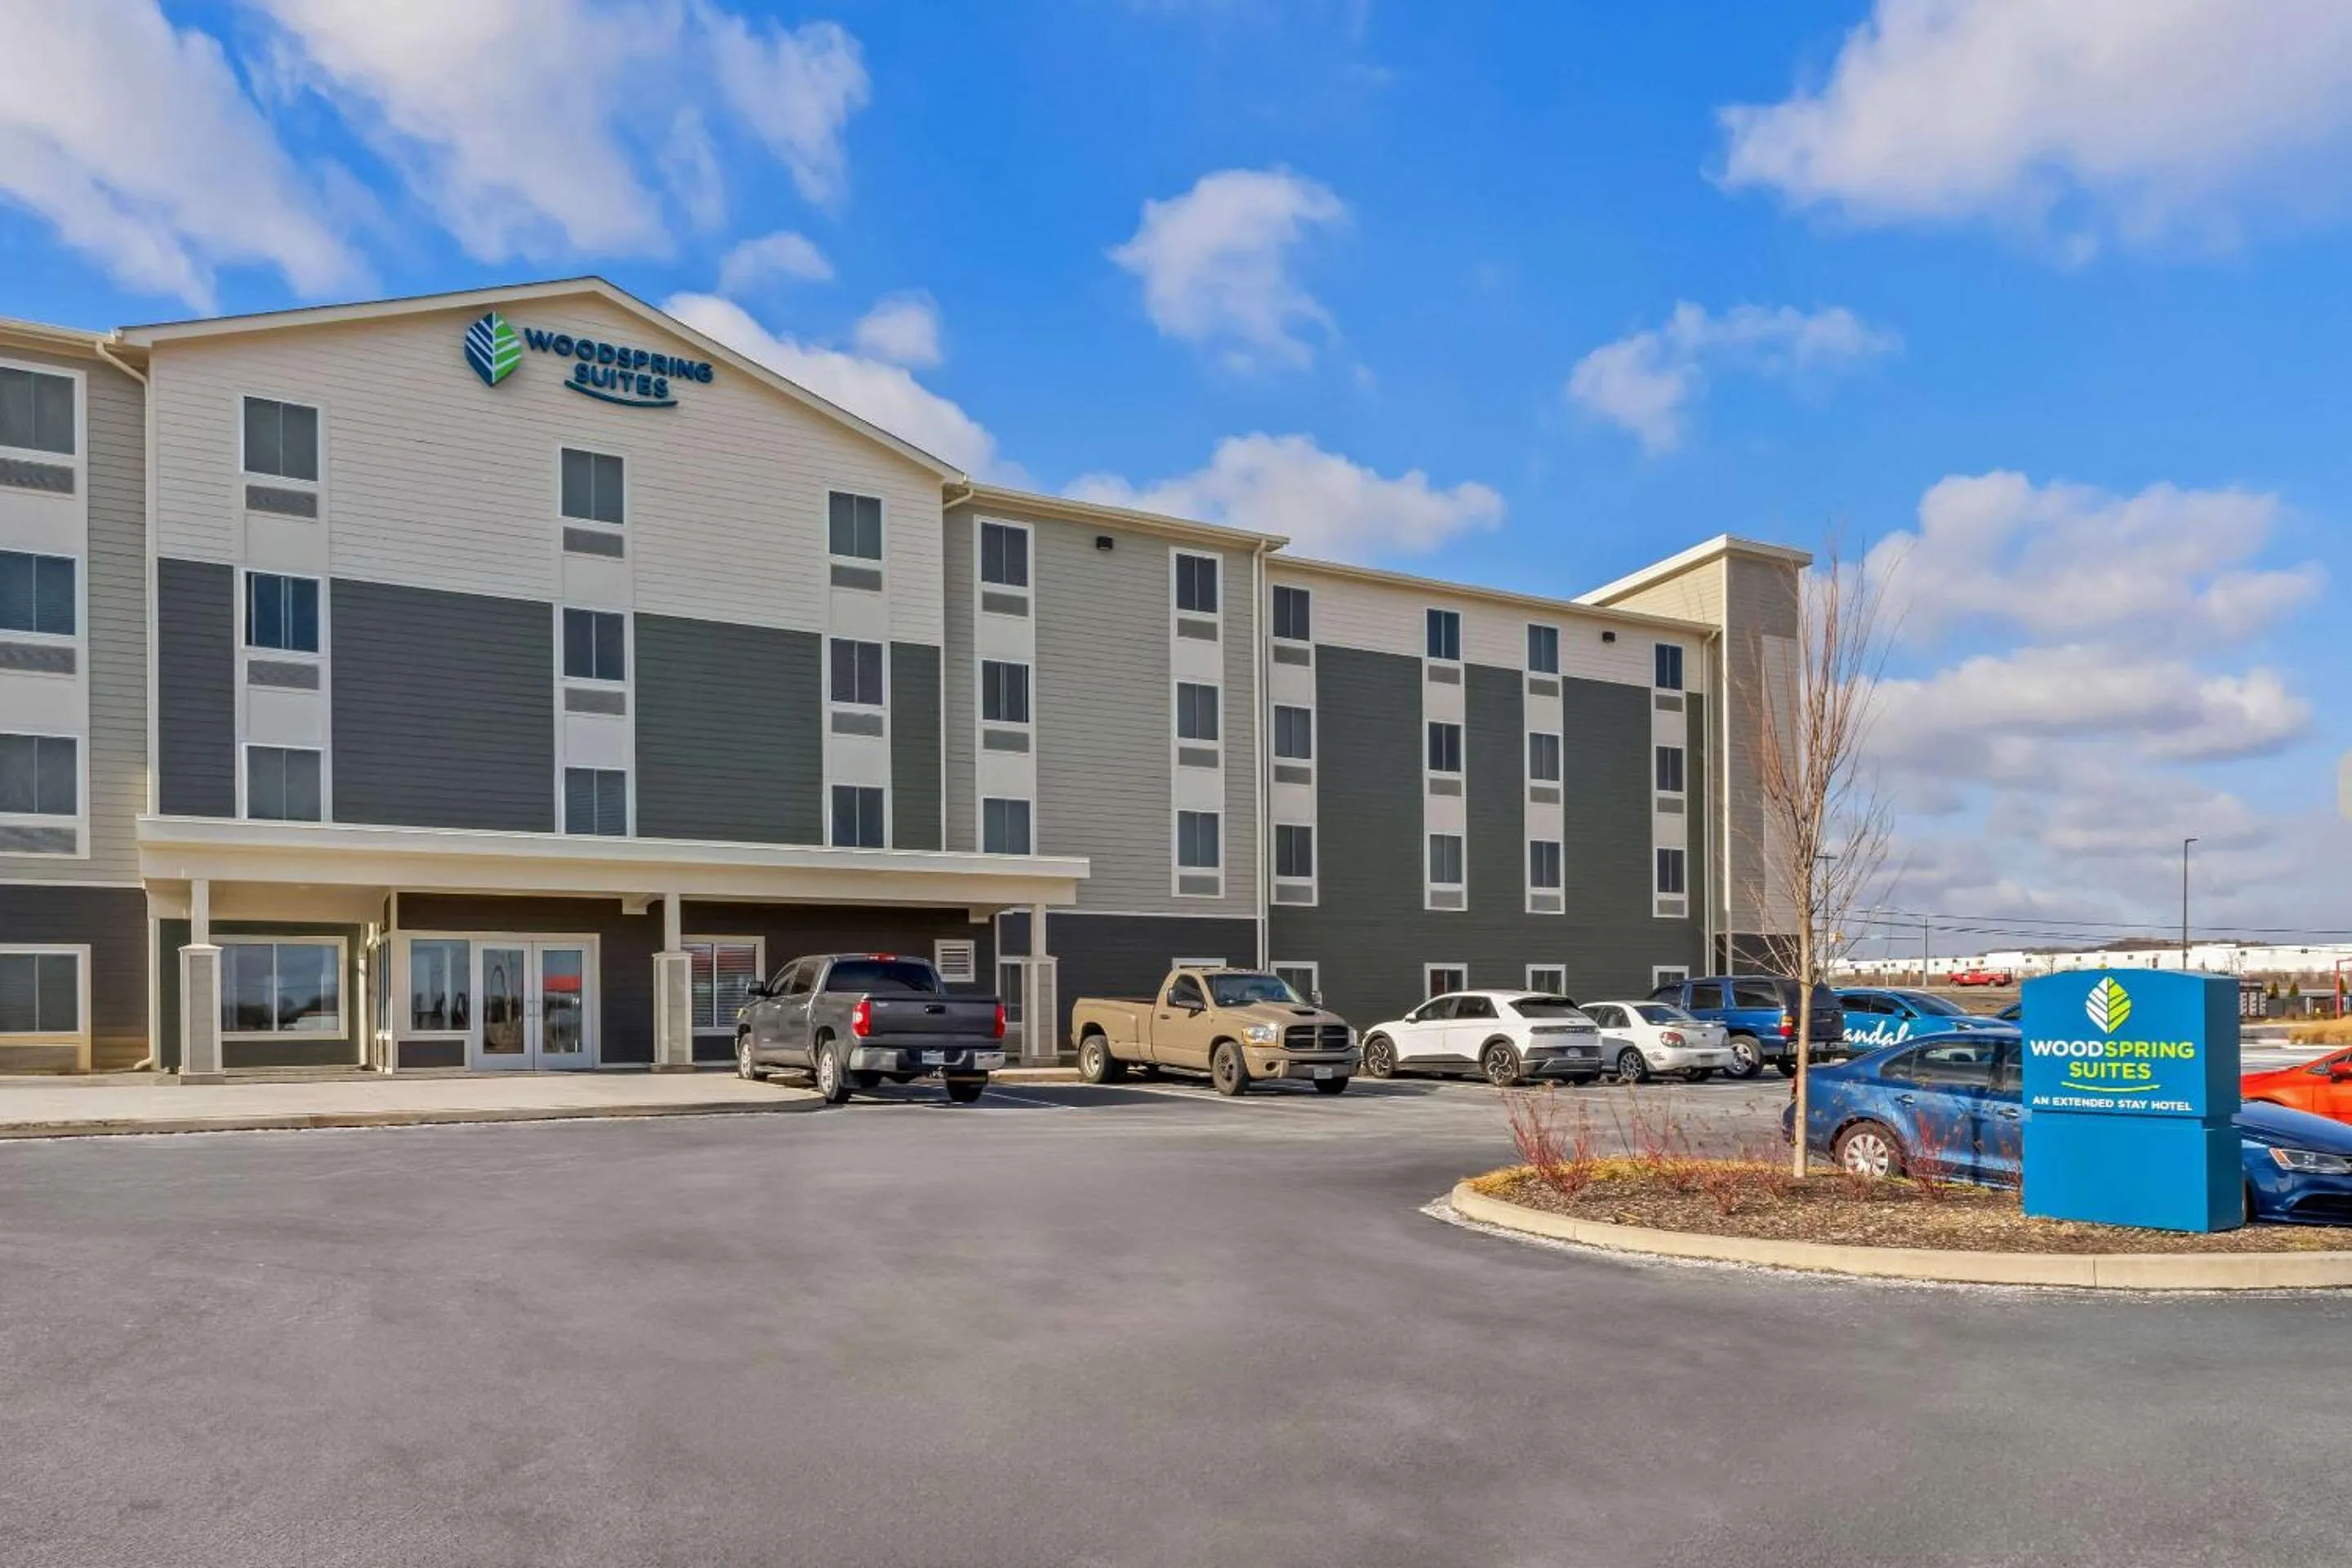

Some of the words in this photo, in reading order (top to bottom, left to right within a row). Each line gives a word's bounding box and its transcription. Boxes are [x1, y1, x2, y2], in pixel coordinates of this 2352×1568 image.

[524, 327, 714, 383] WOODSPRING
[574, 362, 669, 399] SUITES
[1842, 1019, 1914, 1046] andal
[2029, 1040, 2195, 1058] WOODSPRING
[2069, 1062, 2152, 1080] SUITES
[2033, 1096, 2049, 1106] AN
[2052, 1097, 2114, 1108] EXTENDED
[2118, 1099, 2147, 1110] STAY
[2151, 1100, 2193, 1112] HOTEL
